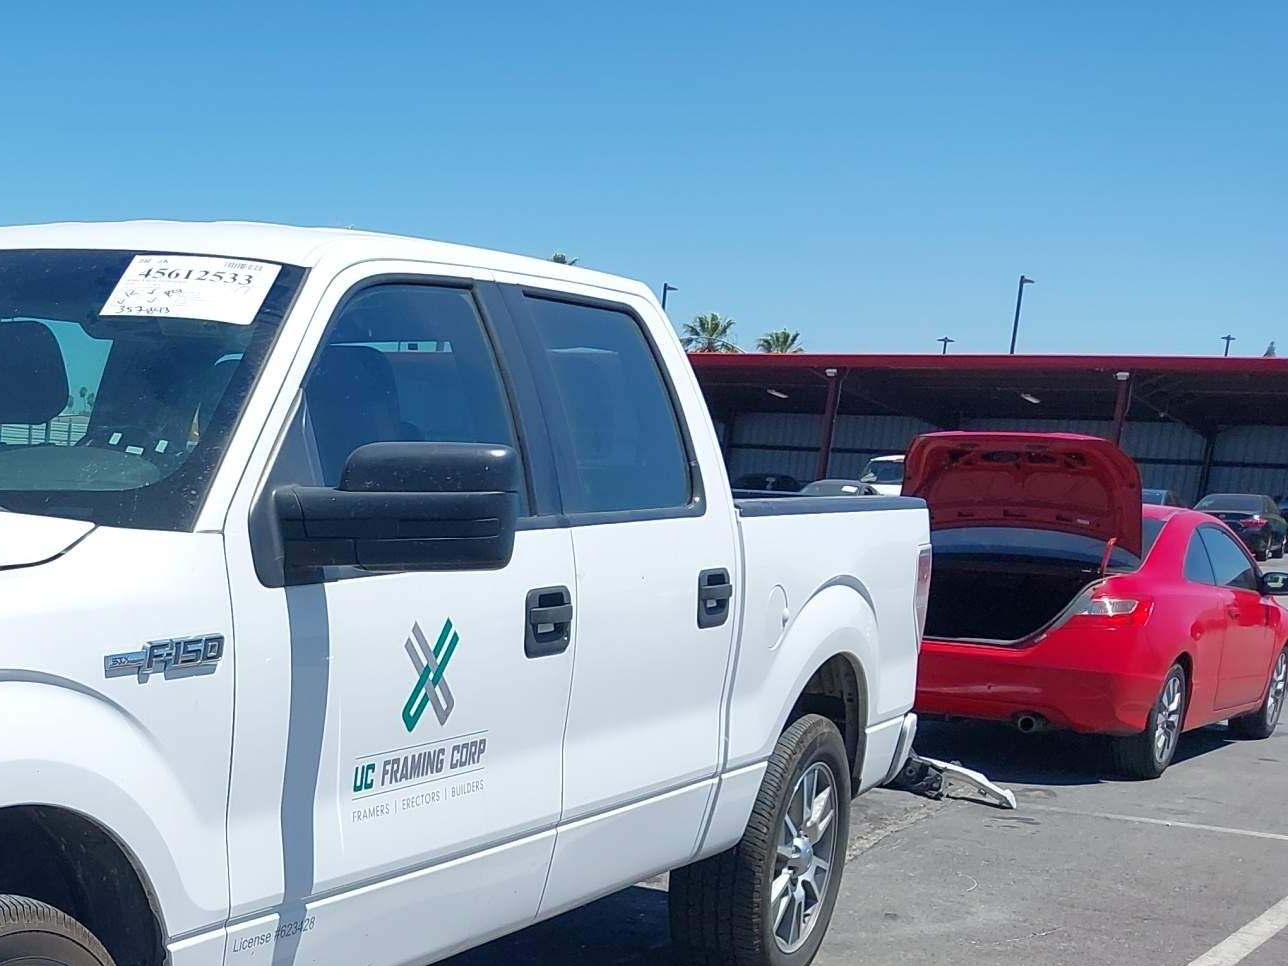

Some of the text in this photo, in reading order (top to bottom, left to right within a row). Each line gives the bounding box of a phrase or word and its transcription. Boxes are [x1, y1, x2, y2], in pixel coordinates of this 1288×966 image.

[138, 267, 254, 286] 45612533
[352, 738, 487, 793] UC FRAMING CORP
[352, 779, 485, 823] FRAMERS ERECTORS BUILDERS
[232, 916, 316, 953] License #623428
